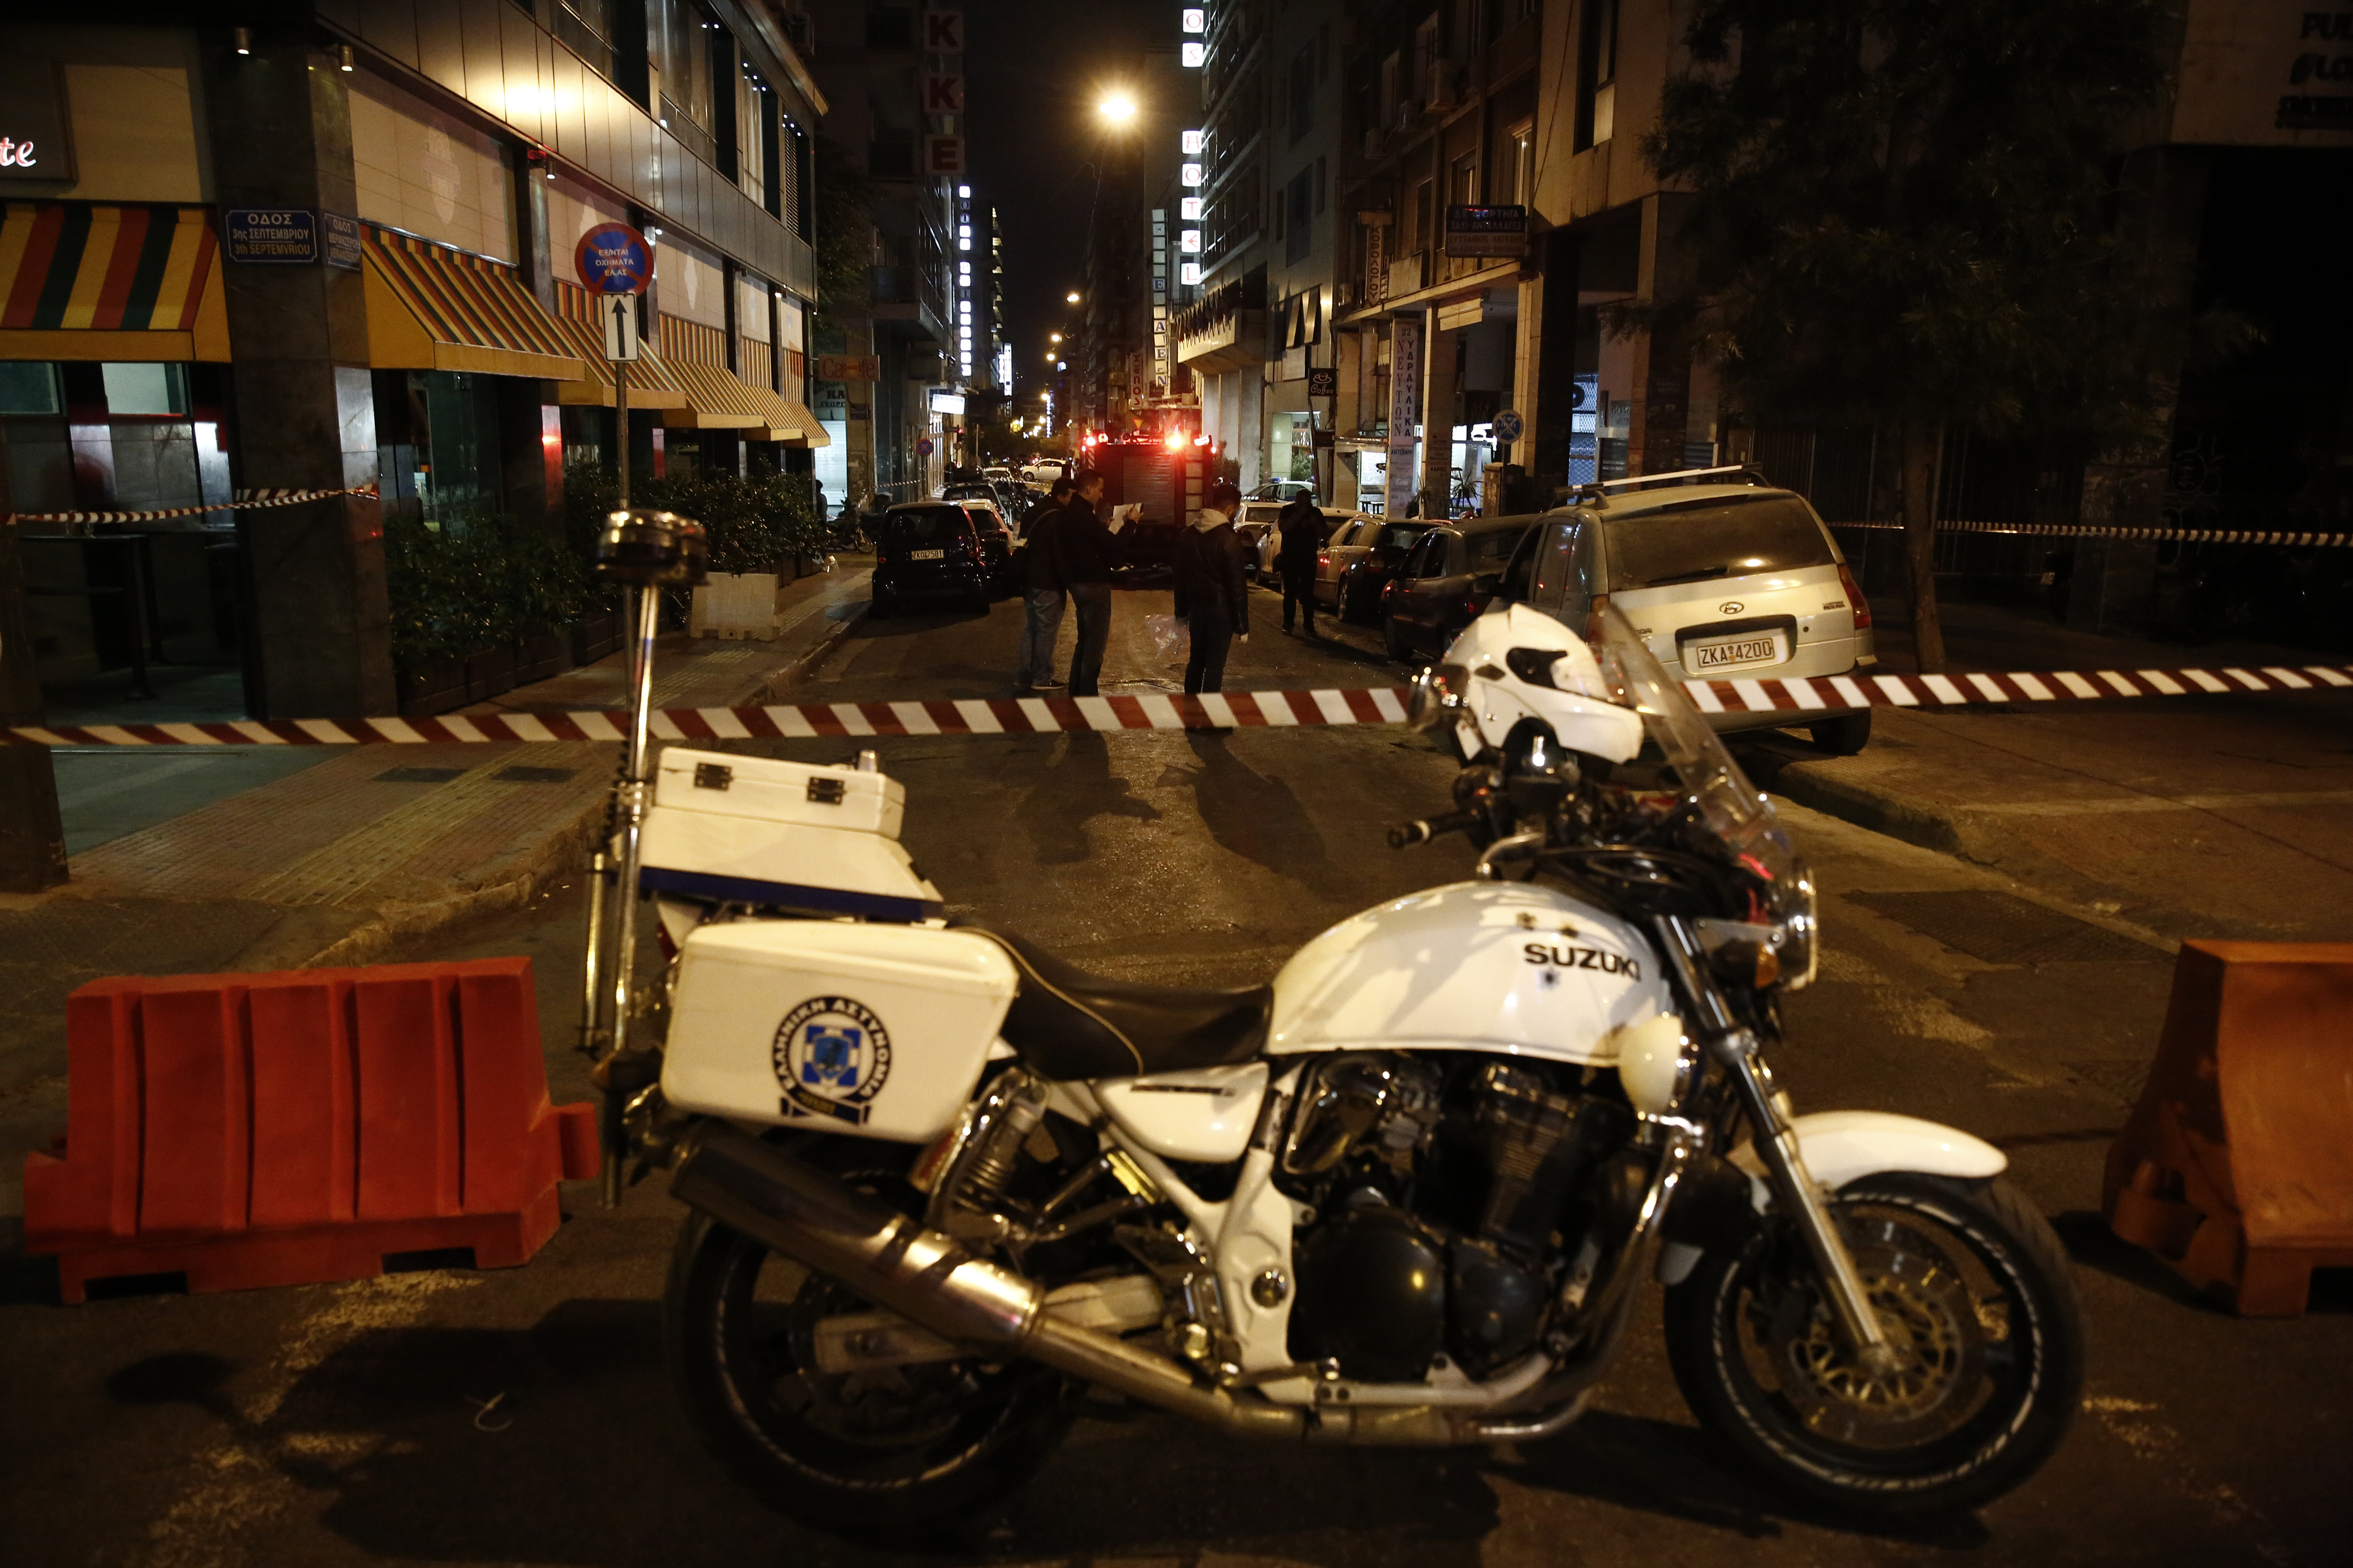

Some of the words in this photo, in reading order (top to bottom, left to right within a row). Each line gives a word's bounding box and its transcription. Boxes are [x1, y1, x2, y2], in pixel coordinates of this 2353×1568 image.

[247, 213, 292, 226] ΟΔΟΣ
[249, 228, 310, 240] ΣΕΠΤΕΜΒΡΙΟΥ
[250, 244, 310, 255] SEPTEMVRIOU
[1311, 383, 1333, 395] Coffee
[1735, 641, 1772, 660] 4200
[1523, 943, 1641, 983] SUZUKI
